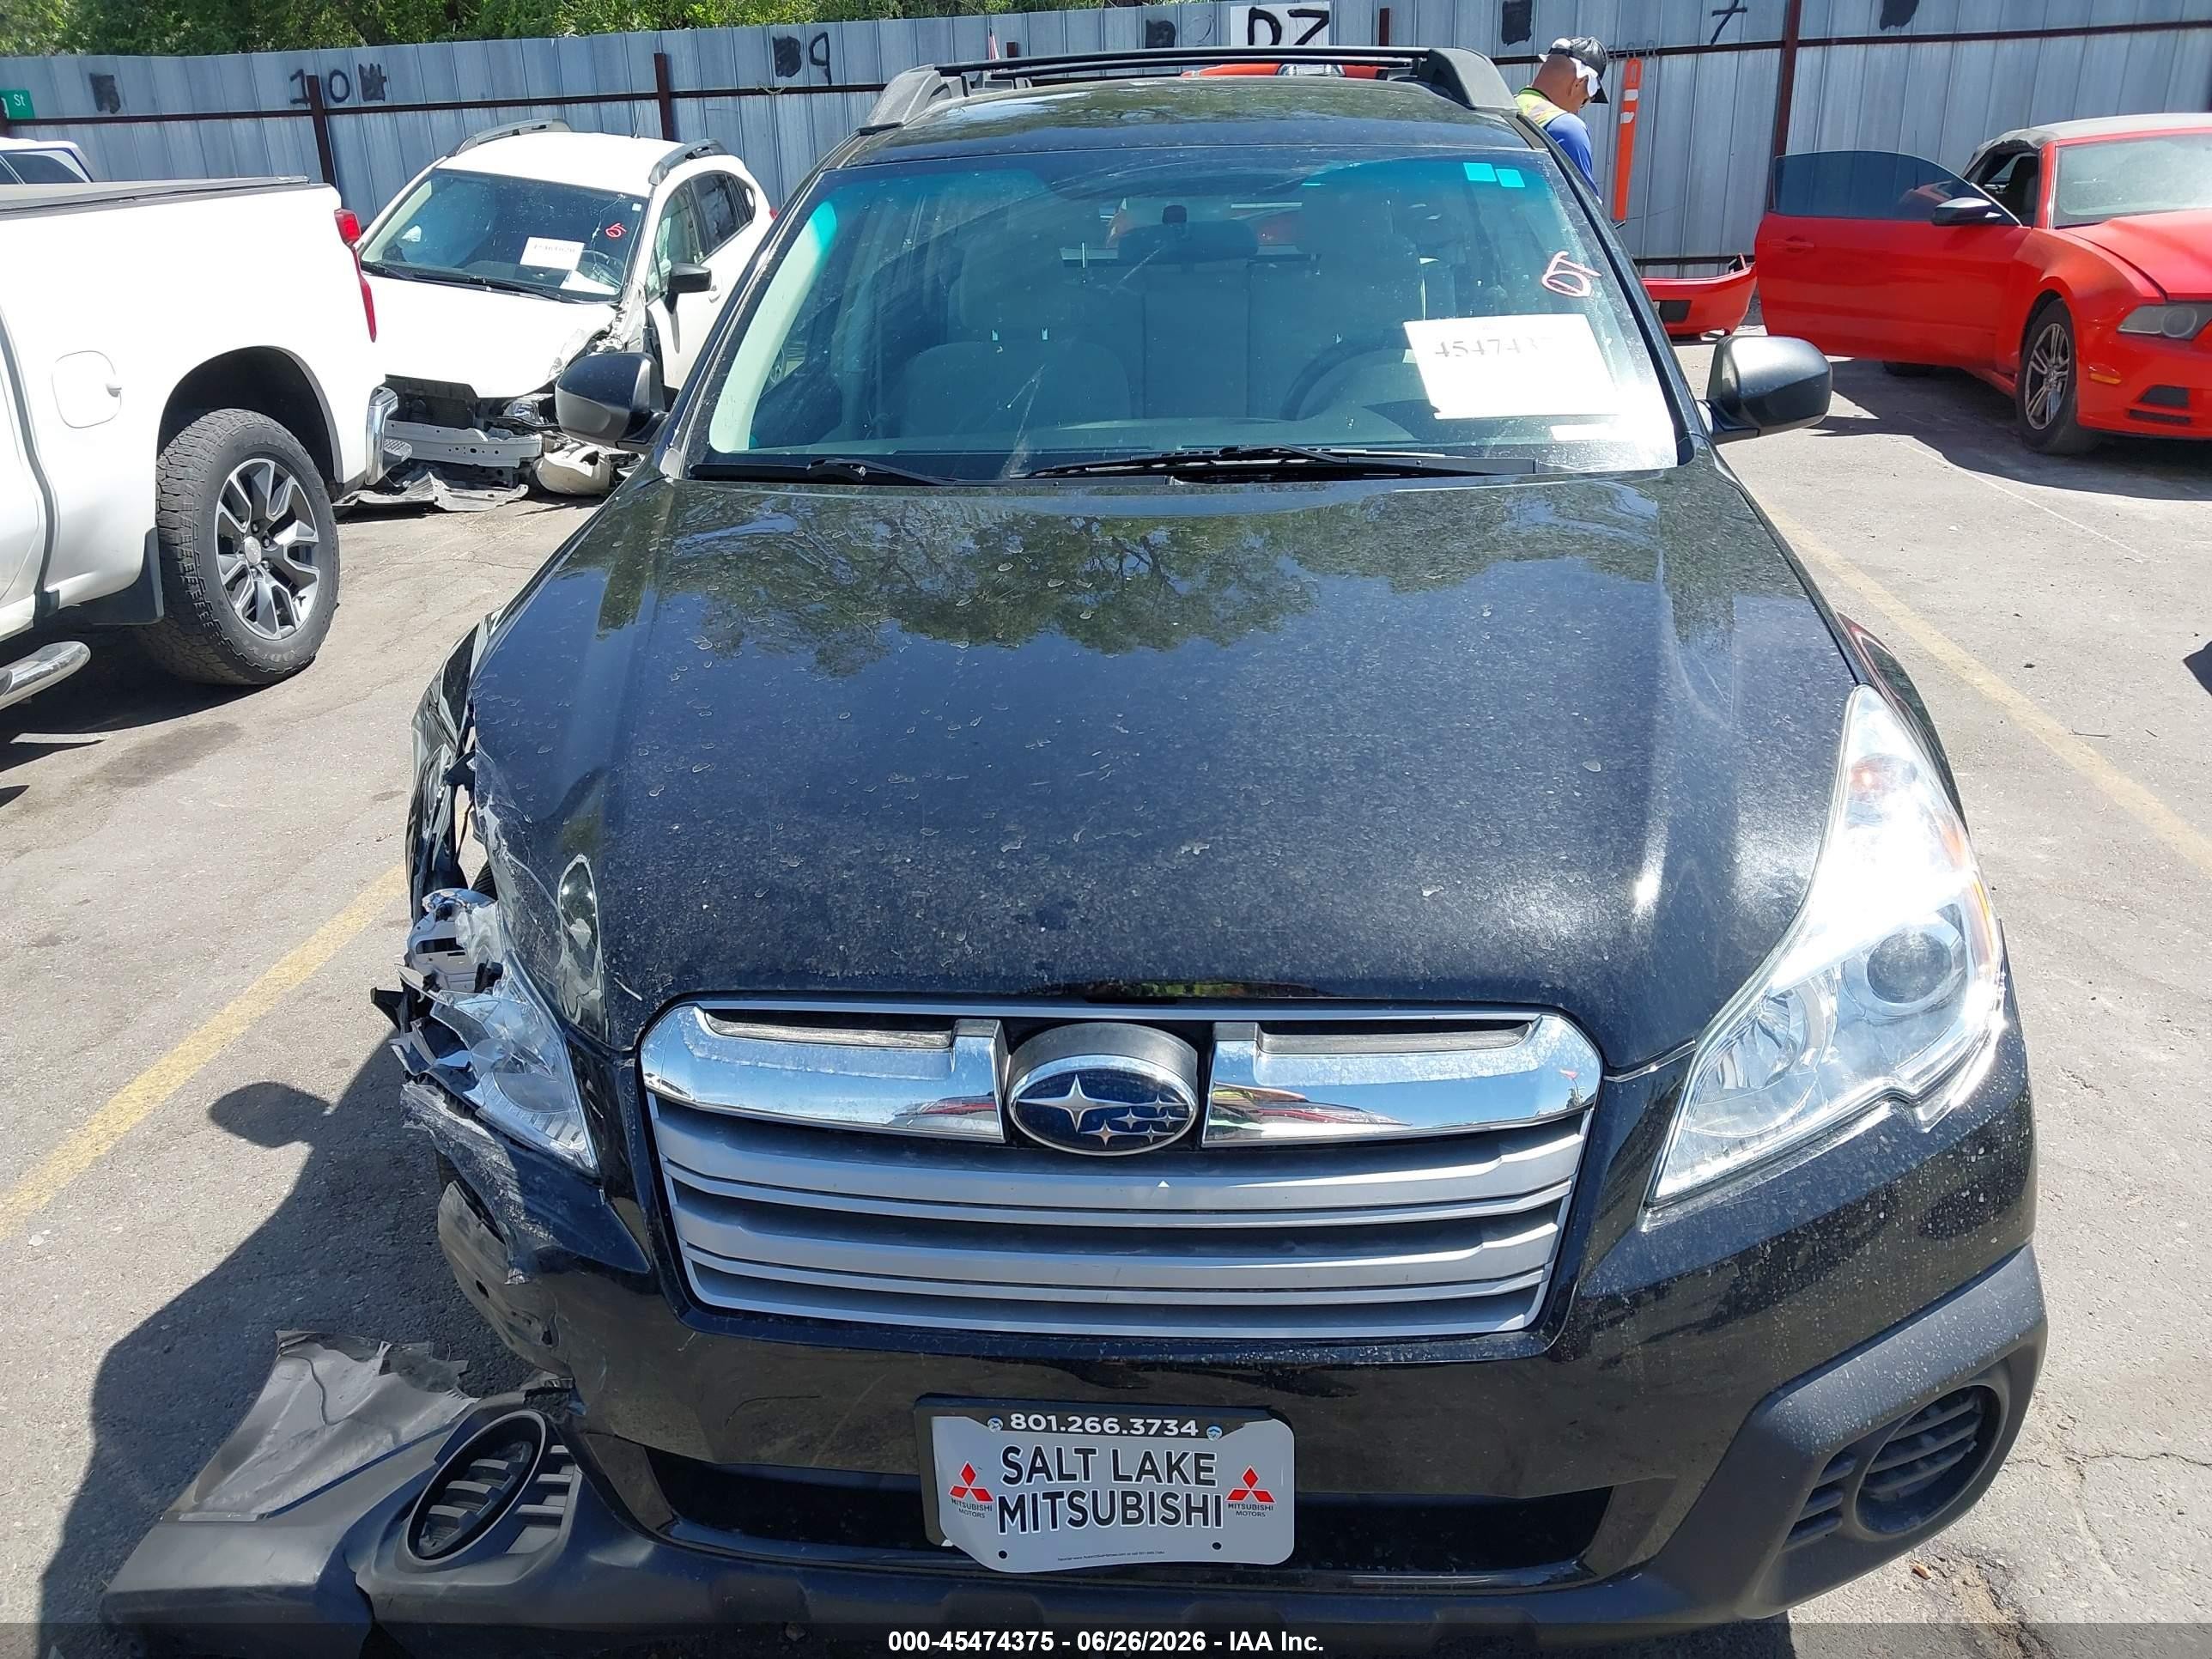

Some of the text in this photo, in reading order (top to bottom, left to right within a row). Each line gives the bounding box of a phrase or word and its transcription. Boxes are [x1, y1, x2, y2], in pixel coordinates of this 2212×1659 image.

[13, 94, 26, 106] St
[1010, 1413, 1199, 1437] 801.266.3734
[1000, 1444, 1218, 1487] SALT LAKE
[951, 1498, 993, 1511] MITSUBISHI
[958, 1508, 986, 1518] MOTORS
[998, 1489, 1223, 1534] MITSUBISHI
